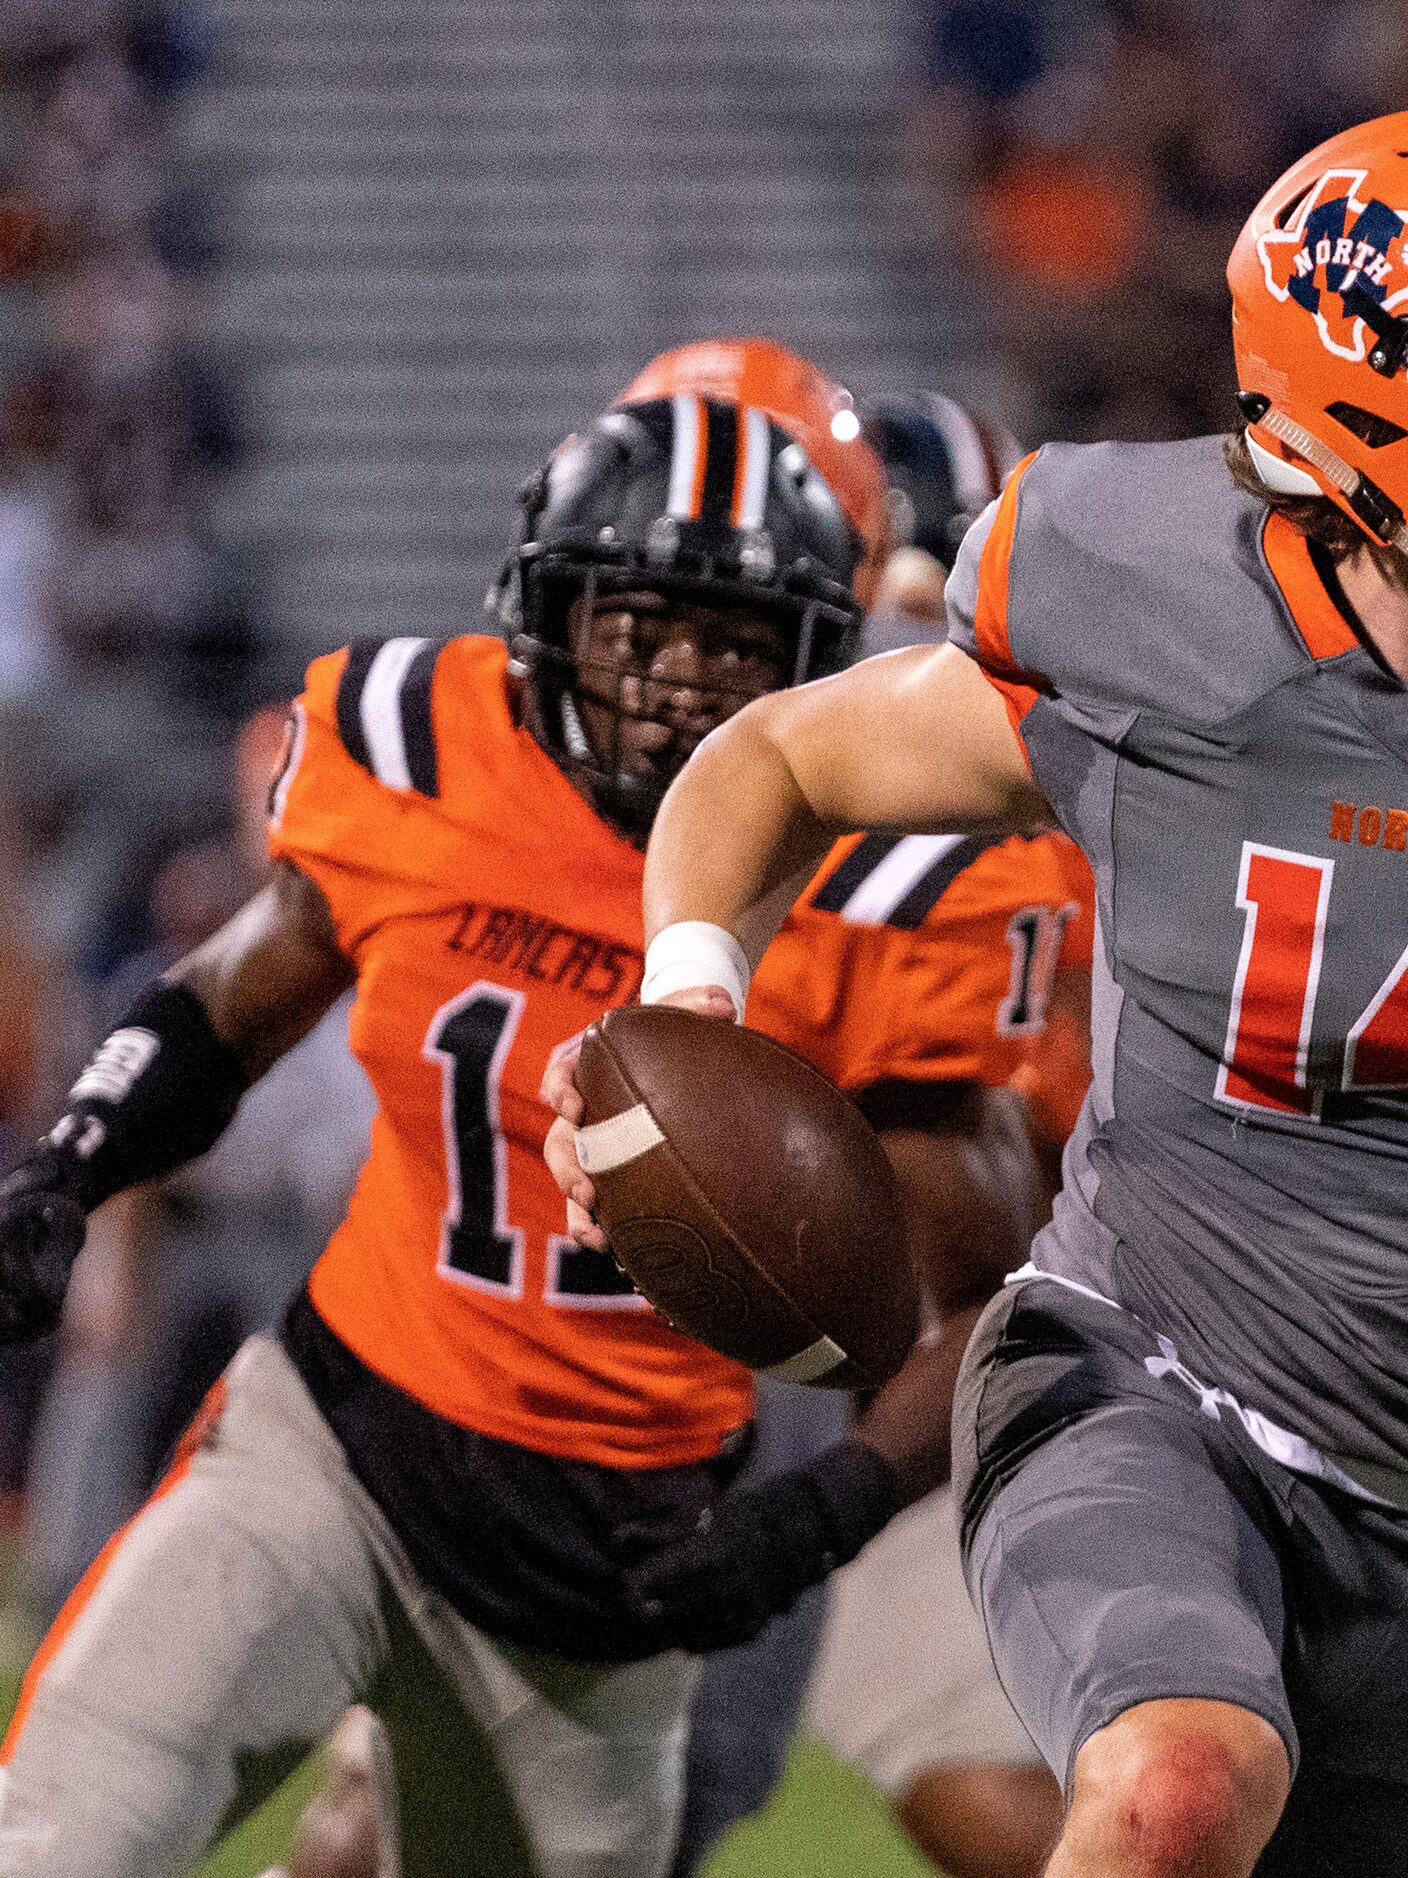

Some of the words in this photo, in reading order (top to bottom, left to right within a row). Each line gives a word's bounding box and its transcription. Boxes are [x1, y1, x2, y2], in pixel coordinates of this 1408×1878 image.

[1292, 237, 1393, 286] NORTH
[447, 900, 645, 1006] LANCAST
[421, 979, 658, 1312] 1
